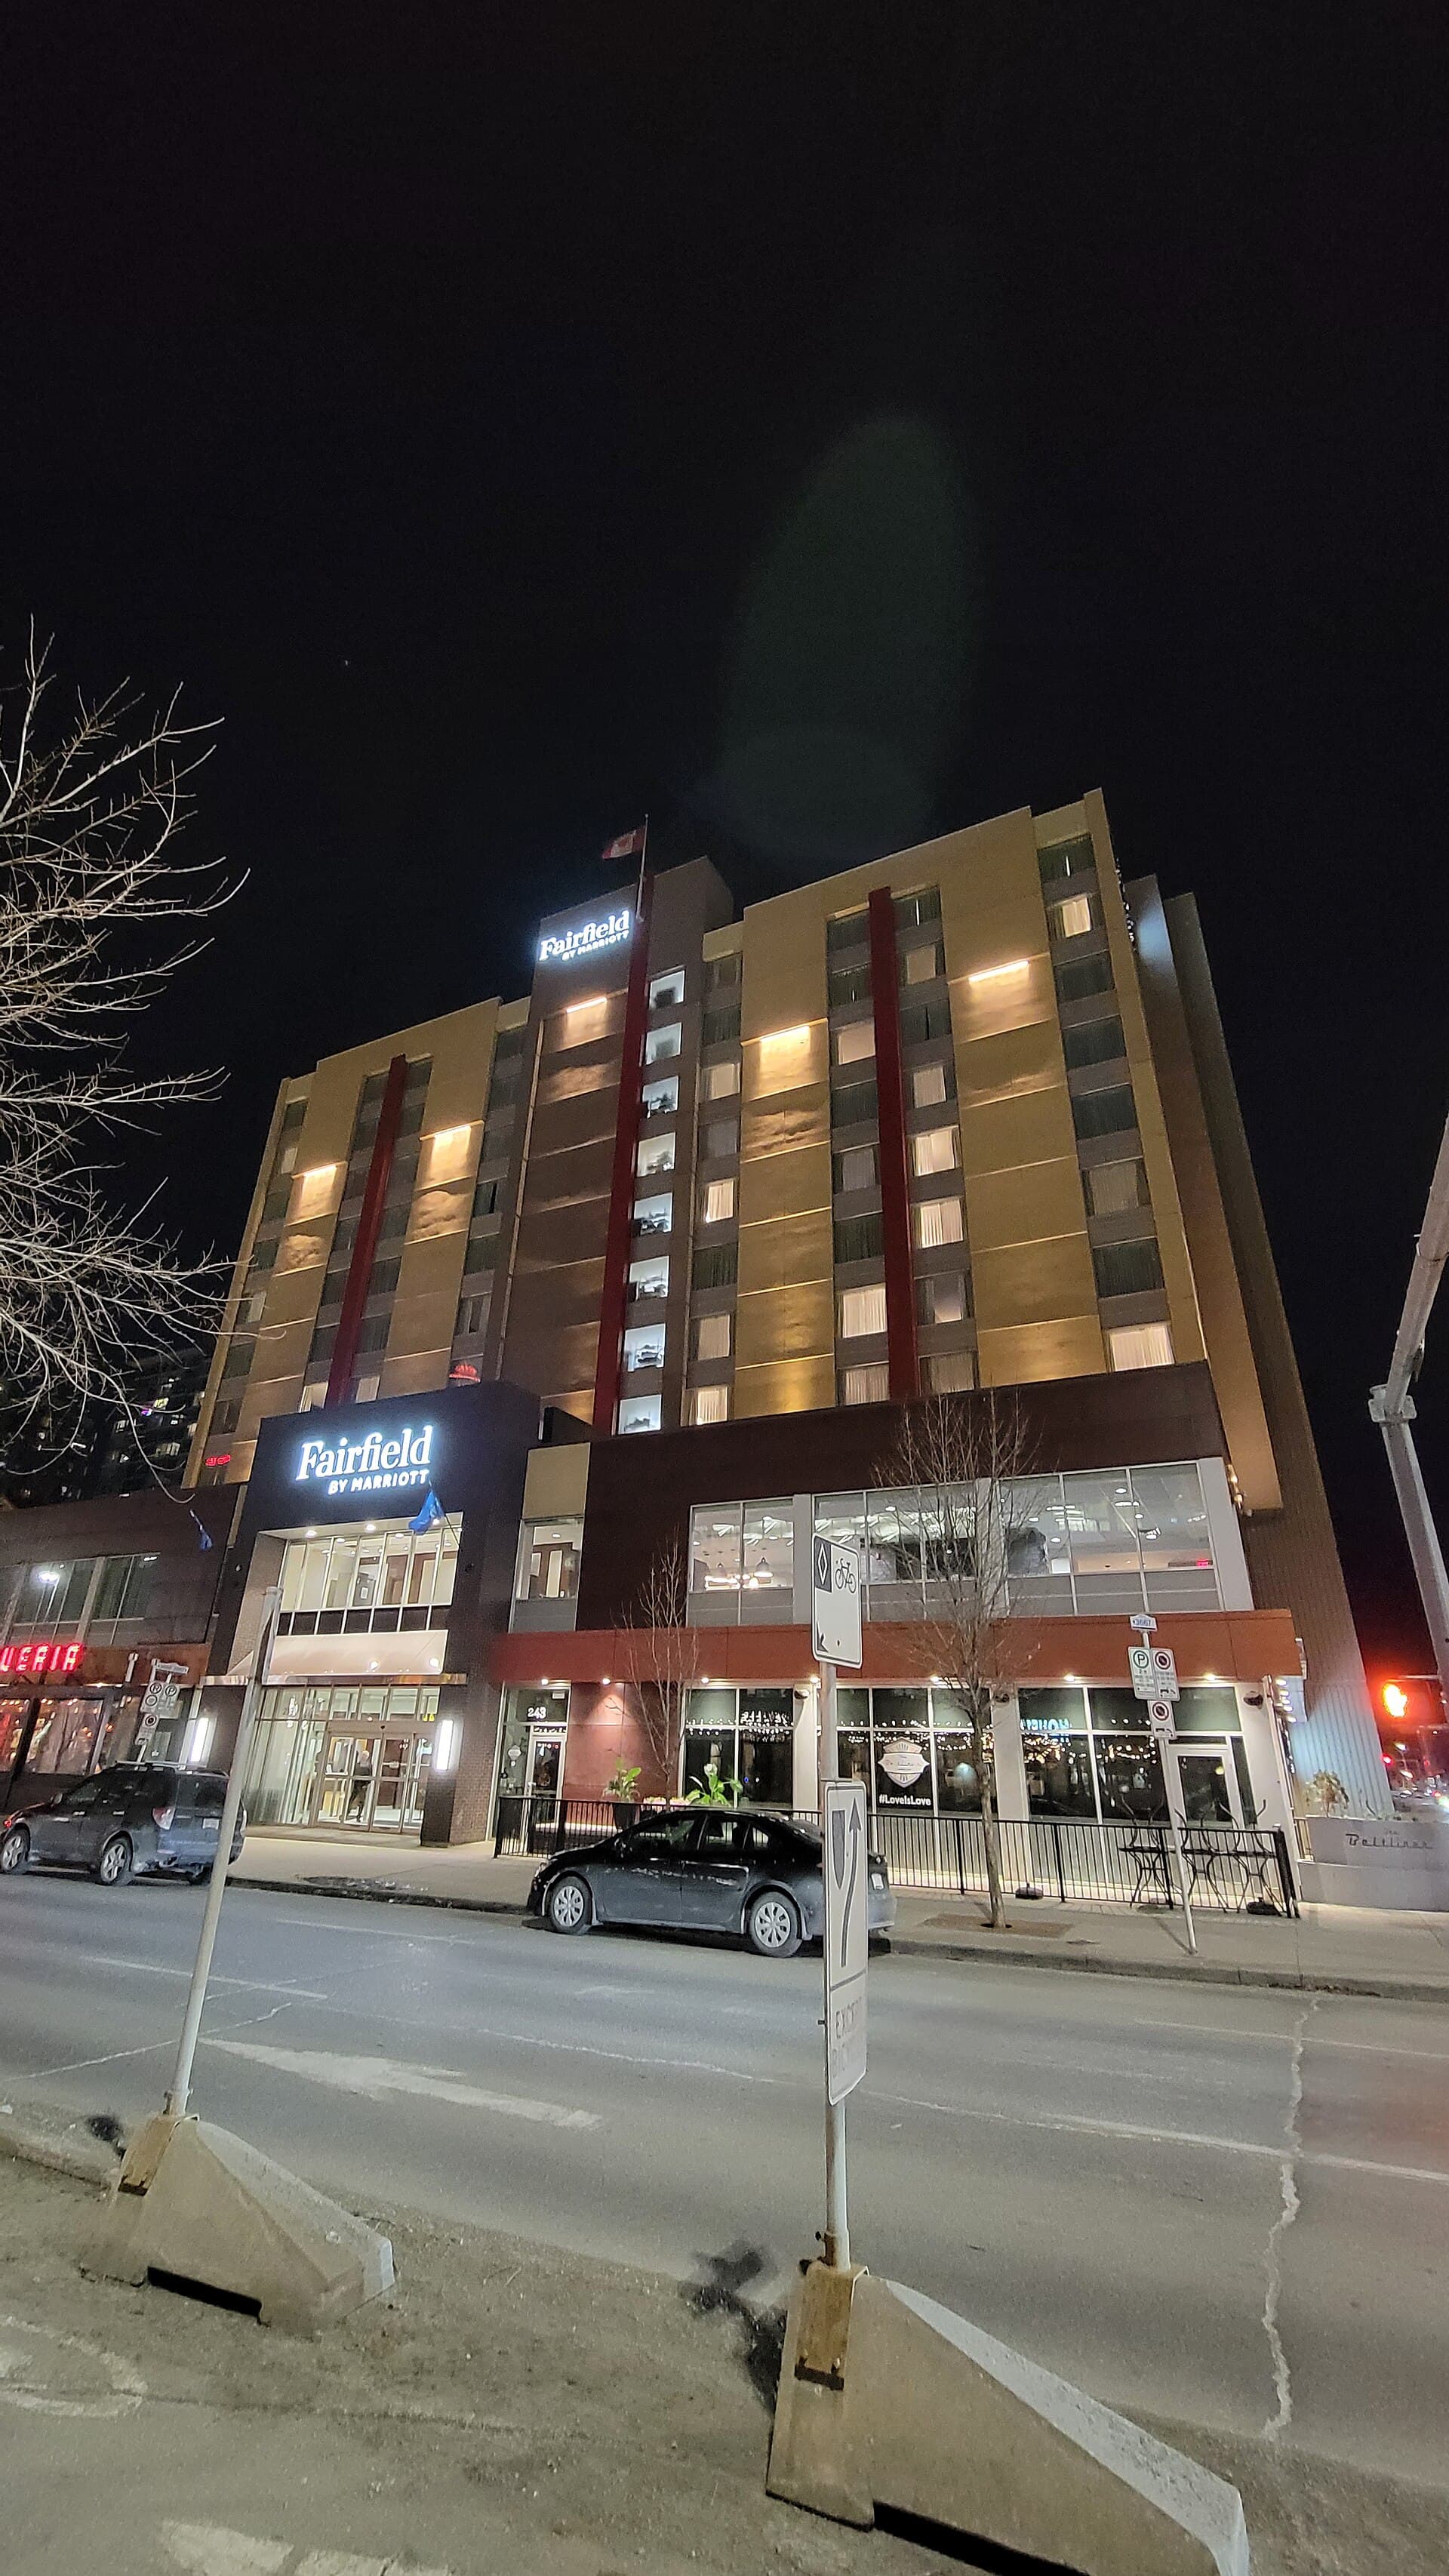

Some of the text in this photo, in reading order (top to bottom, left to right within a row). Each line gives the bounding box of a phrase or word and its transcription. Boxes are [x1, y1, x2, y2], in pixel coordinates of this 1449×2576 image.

[539, 909, 629, 961] Fairfield
[577, 930, 629, 955] MARRIOTT
[295, 1425, 433, 1481] Fairfield
[328, 1470, 430, 1495] BY MARRIOTT
[0, 1643, 82, 1673] UERIA
[528, 1707, 546, 1719] 243
[878, 1793, 931, 1806] #LoveIsLove
